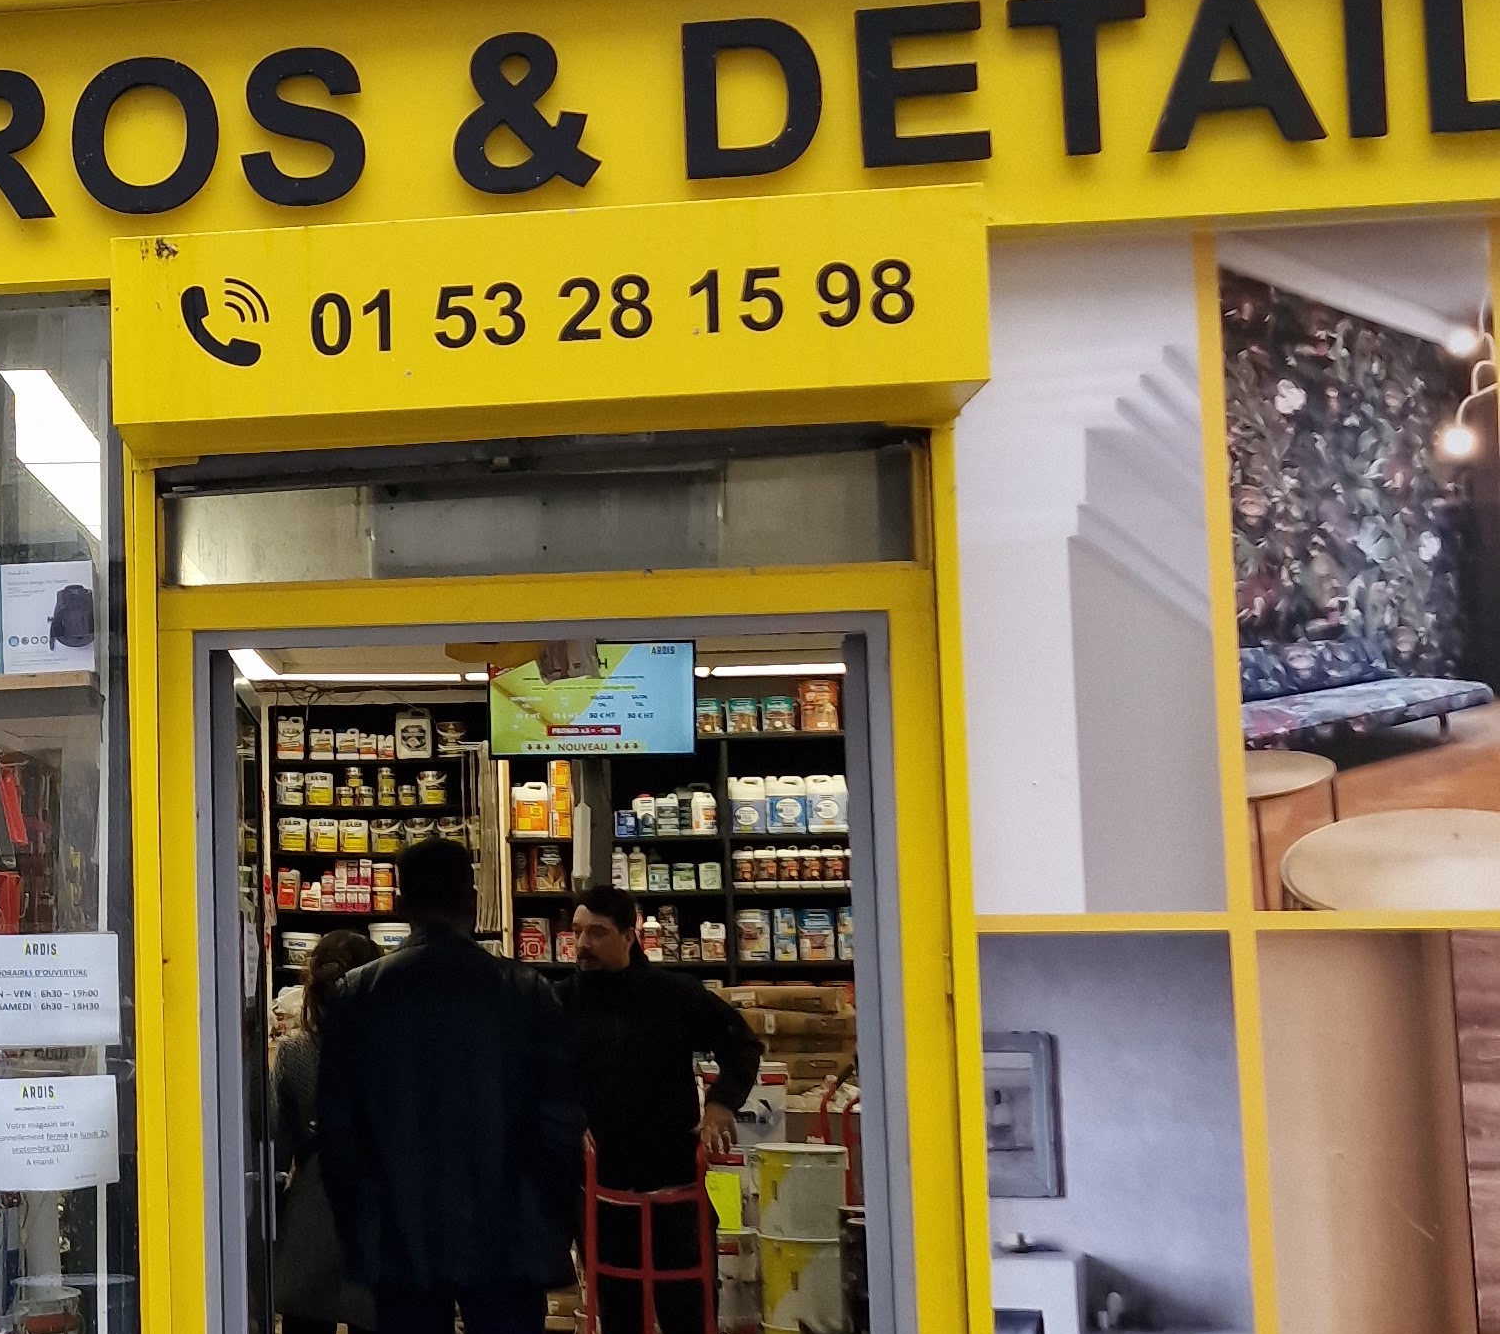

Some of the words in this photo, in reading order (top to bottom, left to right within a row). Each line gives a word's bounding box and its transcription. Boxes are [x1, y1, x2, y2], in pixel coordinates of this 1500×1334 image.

[453, 31, 603, 195] &
[310, 289, 392, 356] 01
[434, 285, 526, 349] 53
[558, 273, 654, 342] 28
[689, 266, 784, 334] 15
[816, 258, 915, 328] 98
[652, 646, 675, 655] ARDIS
[25, 943, 57, 955] ARDIS
[23, 1086, 54, 1099] ARDIS
[28, 1122, 57, 1130] magasin
